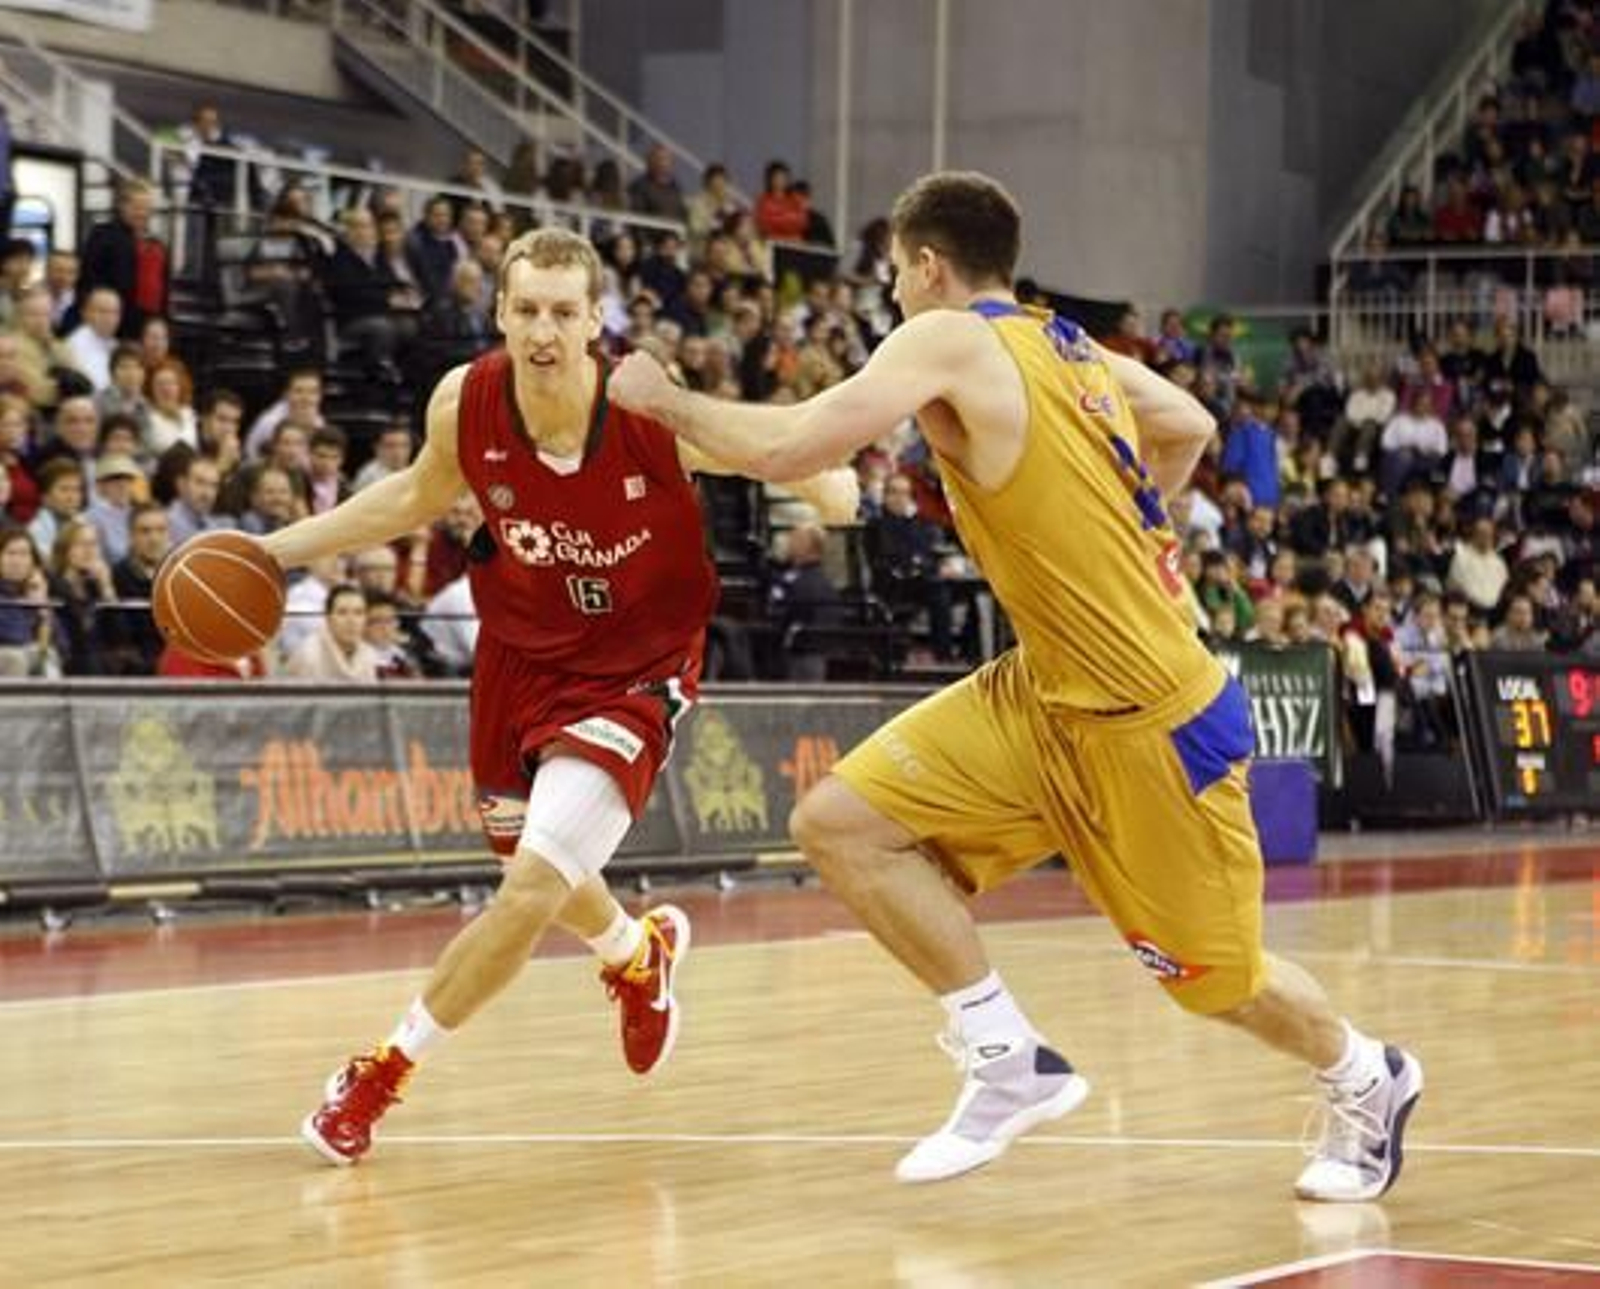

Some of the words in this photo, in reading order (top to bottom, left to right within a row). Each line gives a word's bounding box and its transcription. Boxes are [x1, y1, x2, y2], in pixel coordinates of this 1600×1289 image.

[555, 529, 652, 567] GRANADA
[565, 575, 614, 615] 15
[1250, 696, 1324, 758] HEZ
[1513, 700, 1550, 749] 37
